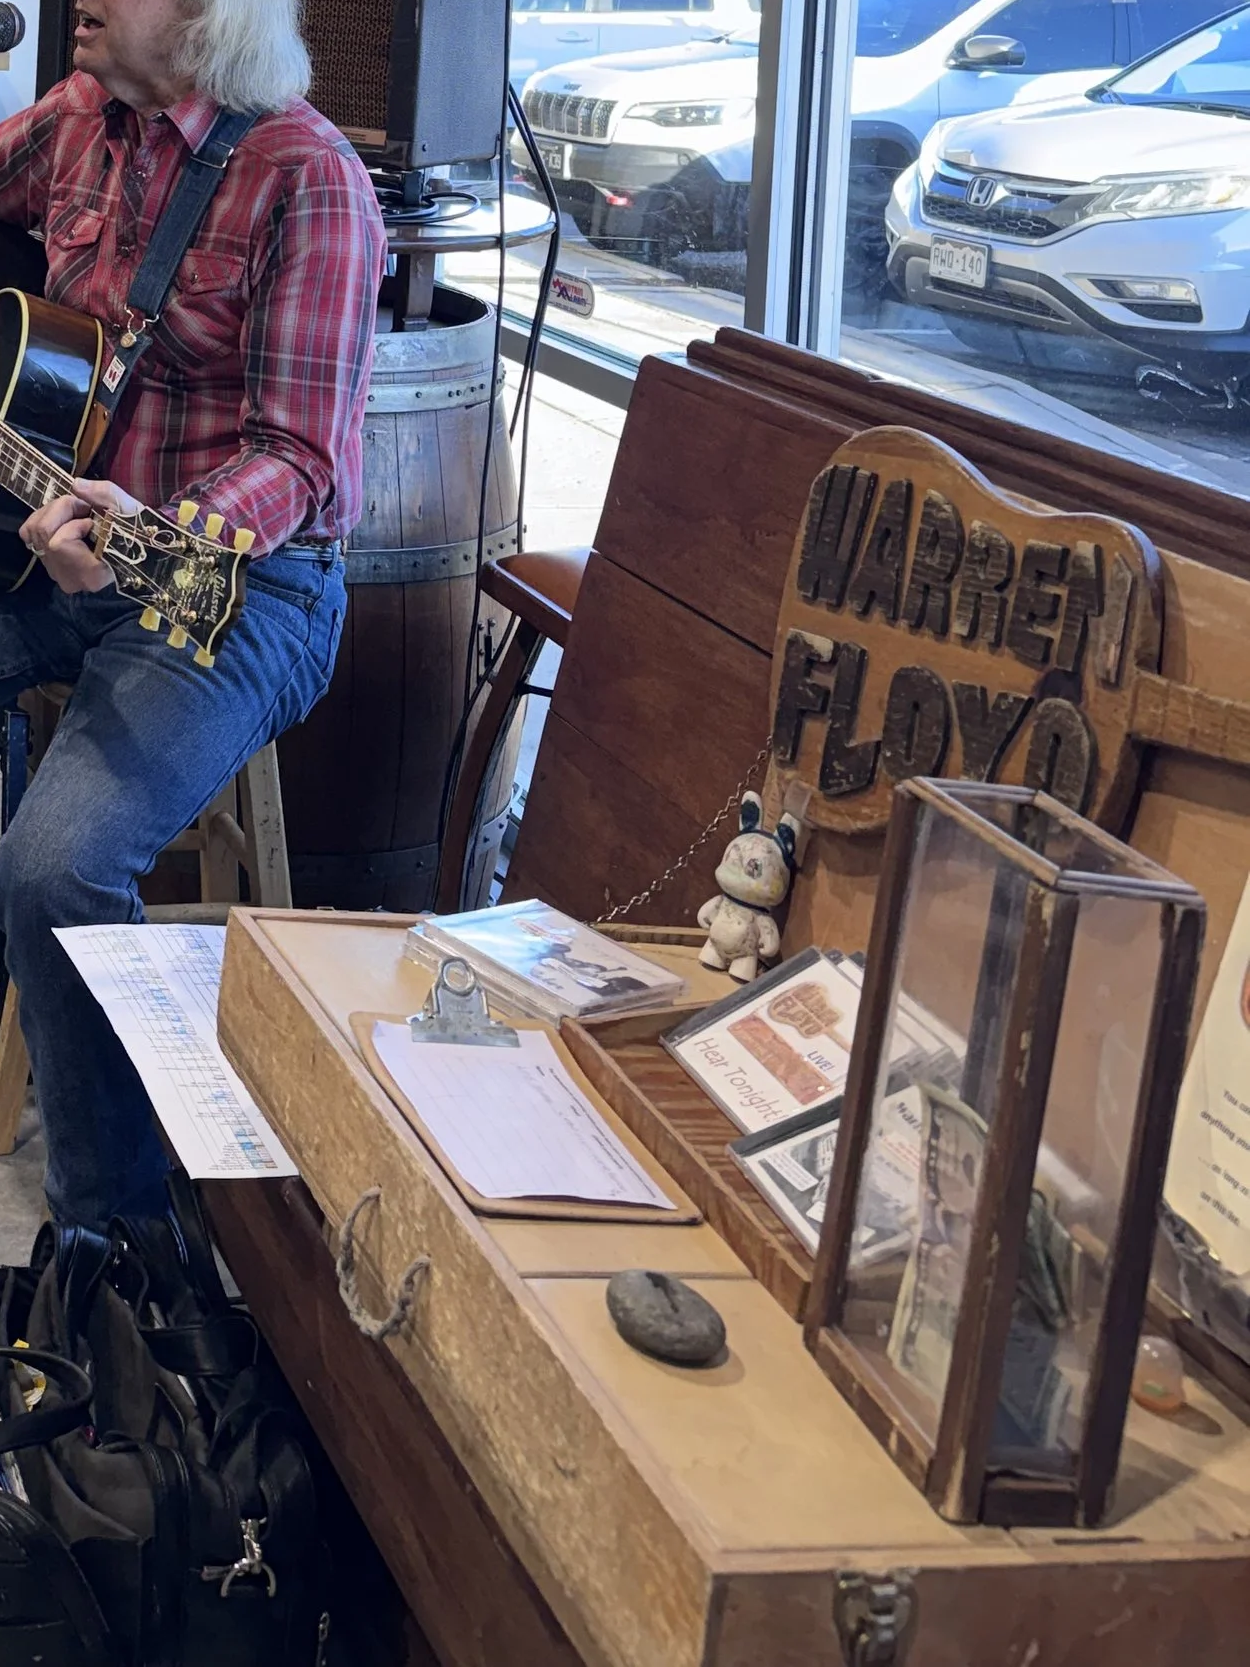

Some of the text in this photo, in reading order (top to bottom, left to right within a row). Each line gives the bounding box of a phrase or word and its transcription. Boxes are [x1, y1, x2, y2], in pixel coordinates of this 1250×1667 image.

[797, 464, 1138, 689] WARREN
[694, 1037, 788, 1123] Hear Tonight!
[807, 1050, 836, 1073] LIVE!
[1200, 1110, 1236, 1141] anything
